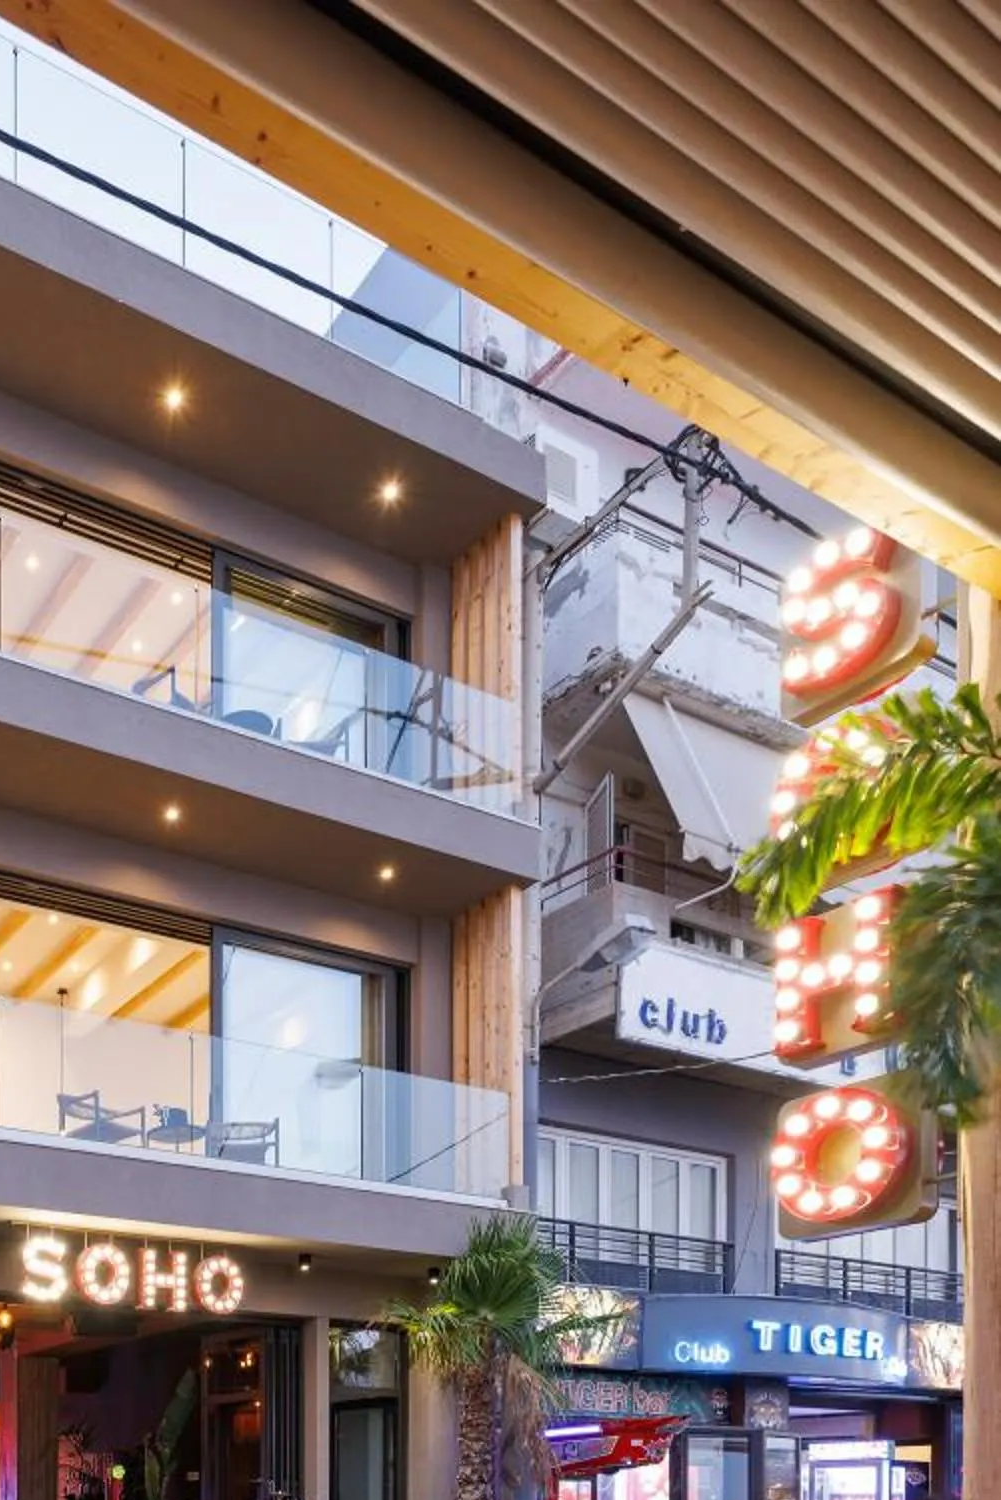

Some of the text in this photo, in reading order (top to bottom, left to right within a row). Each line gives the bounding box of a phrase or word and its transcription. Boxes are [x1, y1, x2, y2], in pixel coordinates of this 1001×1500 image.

[21, 1236, 245, 1315] SOHO
[673, 1319, 884, 1364] Club TIGER
